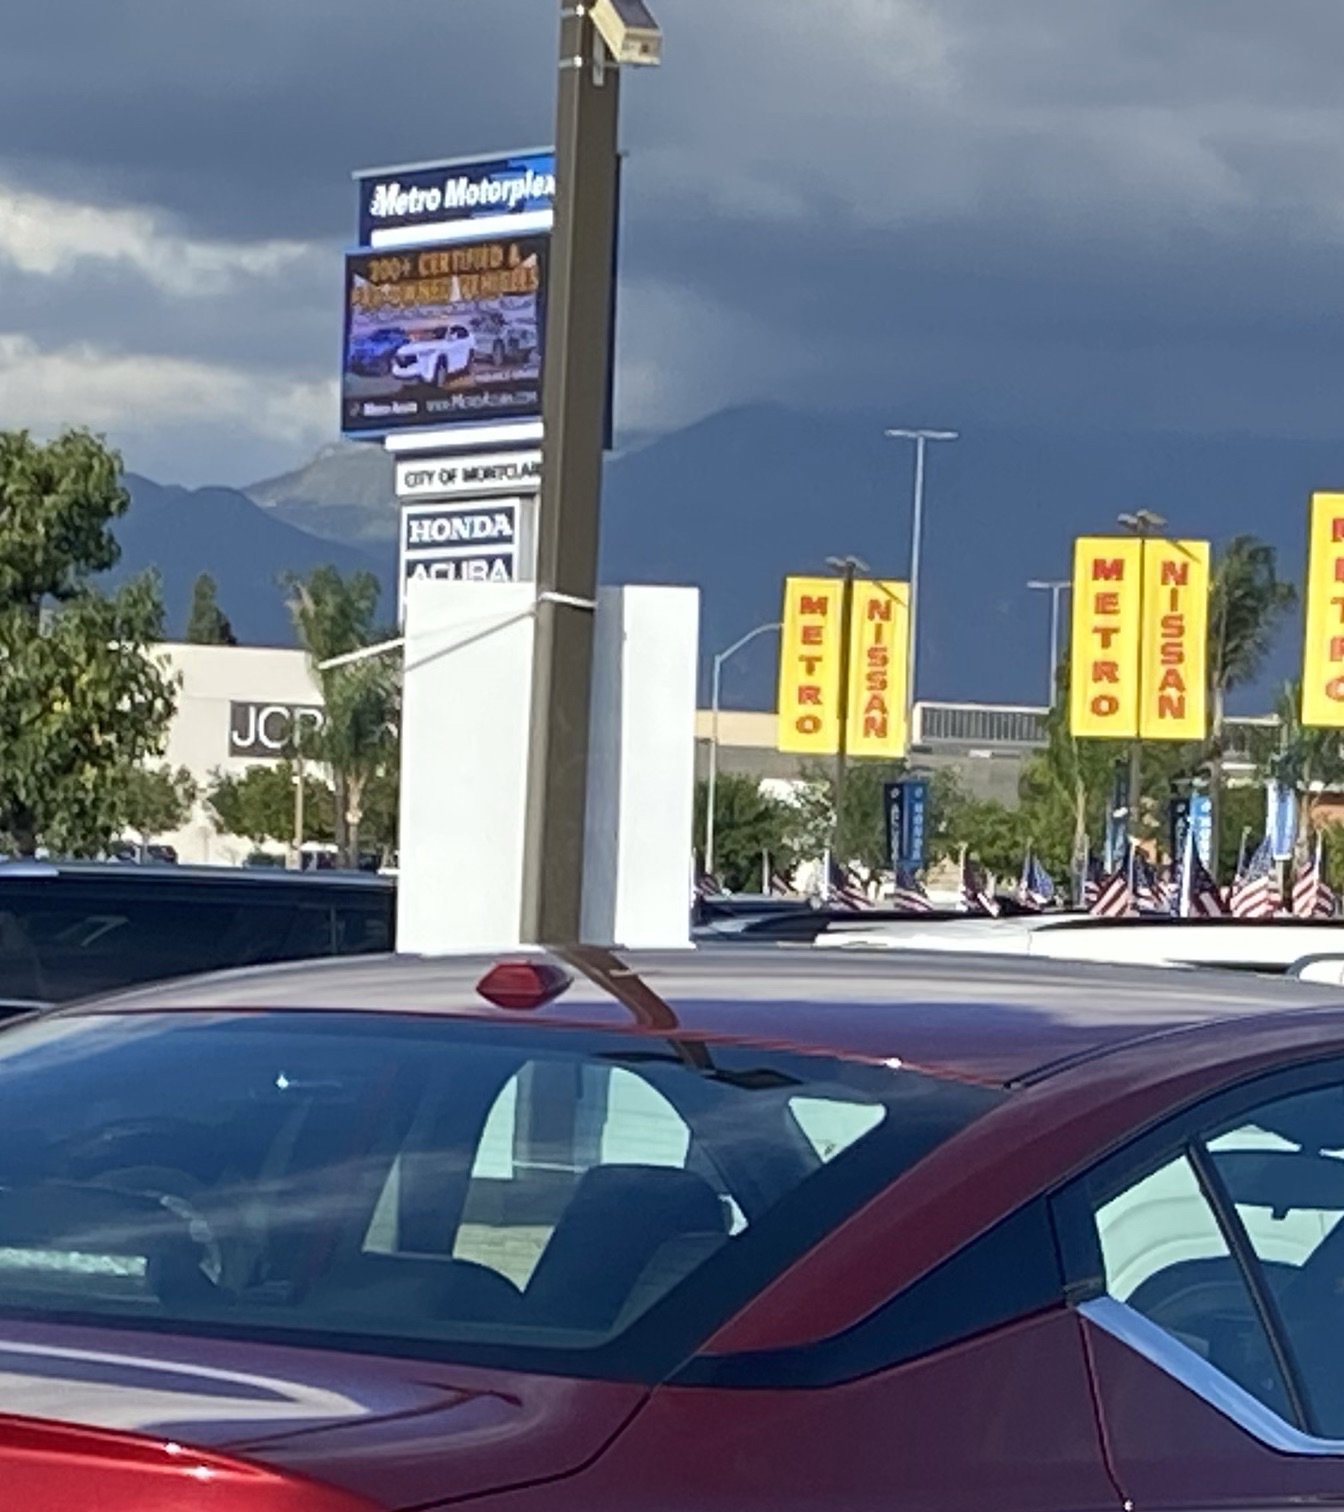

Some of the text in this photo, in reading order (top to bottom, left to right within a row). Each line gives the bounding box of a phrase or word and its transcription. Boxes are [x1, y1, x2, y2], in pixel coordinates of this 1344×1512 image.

[372, 183, 441, 217] Metro
[404, 470, 436, 488] CITY
[438, 468, 458, 485] OF
[408, 513, 513, 543] HONDA
[795, 595, 828, 734] METRO
[863, 598, 892, 738] NISSAN
[1090, 558, 1125, 717] METRO
[1158, 560, 1189, 719] NISSAN
